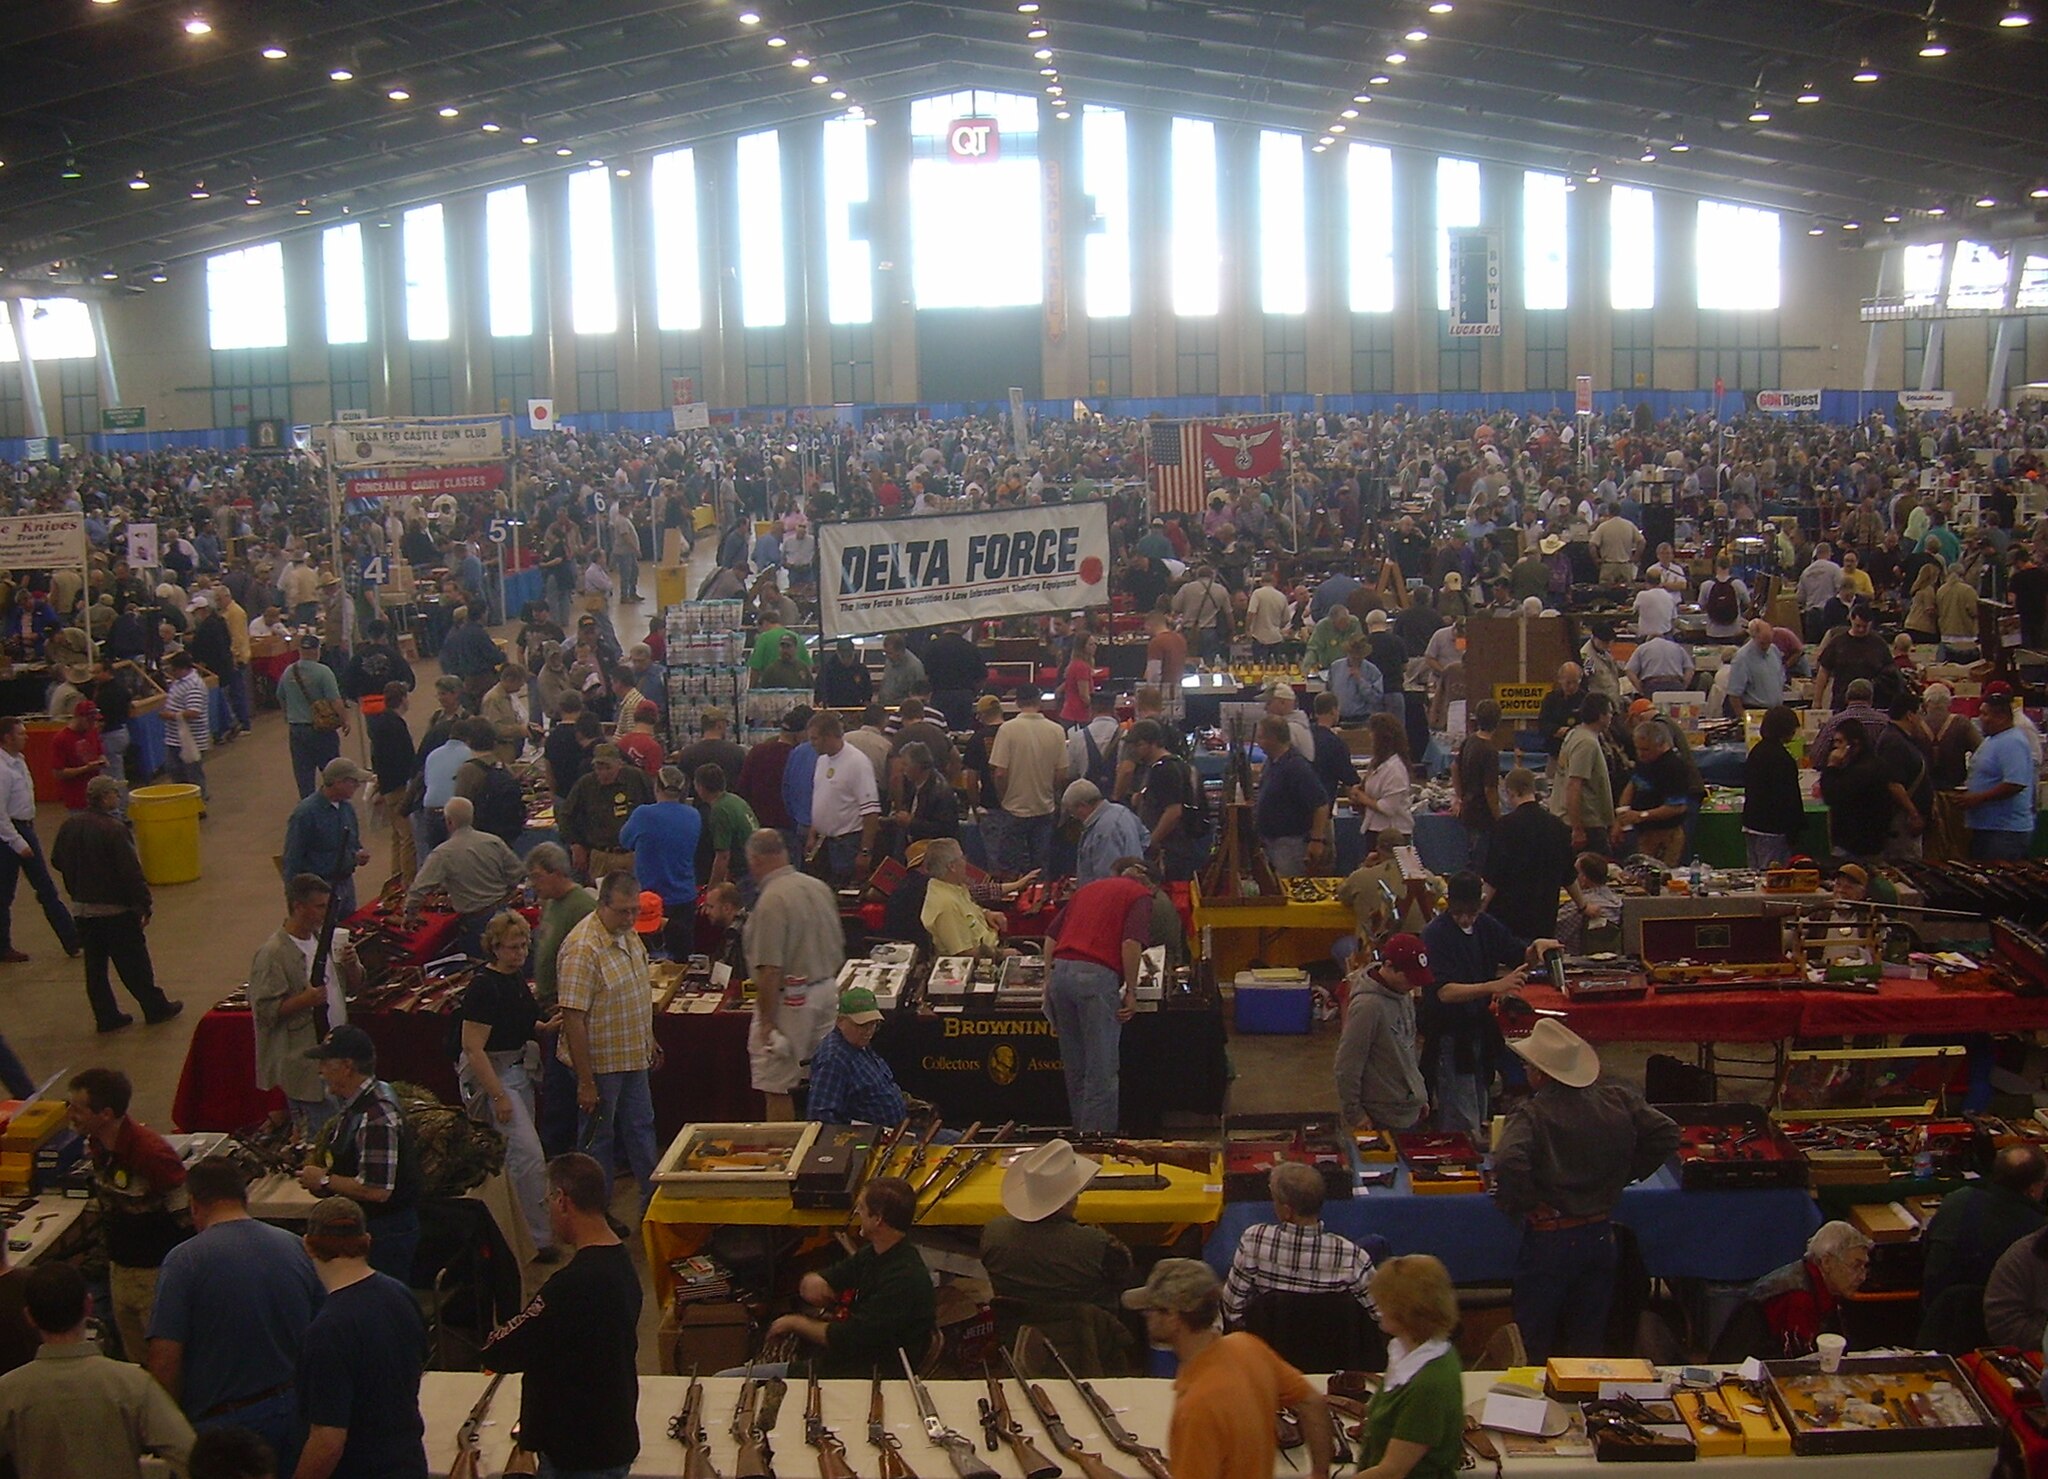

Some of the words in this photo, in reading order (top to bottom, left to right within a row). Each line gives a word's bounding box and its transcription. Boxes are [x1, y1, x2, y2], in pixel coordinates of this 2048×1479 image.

[951, 126, 991, 157] QT
[1488, 250, 1499, 310] BOWL
[1450, 325, 1481, 335] LUCAS
[1484, 324, 1500, 335] OIL
[1759, 394, 1782, 407] GUN
[1783, 394, 1819, 407] Digest
[350, 432, 379, 442] TULSA
[382, 430, 400, 441] RED
[403, 429, 438, 441] CASTLE
[442, 429, 460, 440] GUN
[465, 428, 487, 439] CLUB
[355, 480, 407, 494] CONCEALED
[411, 479, 440, 491] CARRY
[443, 475, 487, 488] CLASSES
[645, 479, 658, 496] 7
[594, 492, 606, 512] 6
[22, 520, 78, 533] Knives
[488, 519, 507, 543] 5
[17, 533, 49, 541] Trade
[839, 539, 950, 595] DELTA
[966, 527, 1080, 583] FORCE
[363, 556, 386, 584] 4
[840, 602, 854, 613] The
[873, 599, 893, 609] Force
[952, 590, 967, 600] Law
[1042, 578, 1077, 591] Equipment
[1501, 688, 1544, 698] COMBAT
[1500, 700, 1540, 709] SHOTGU
[921, 1055, 981, 1071] Collectors
